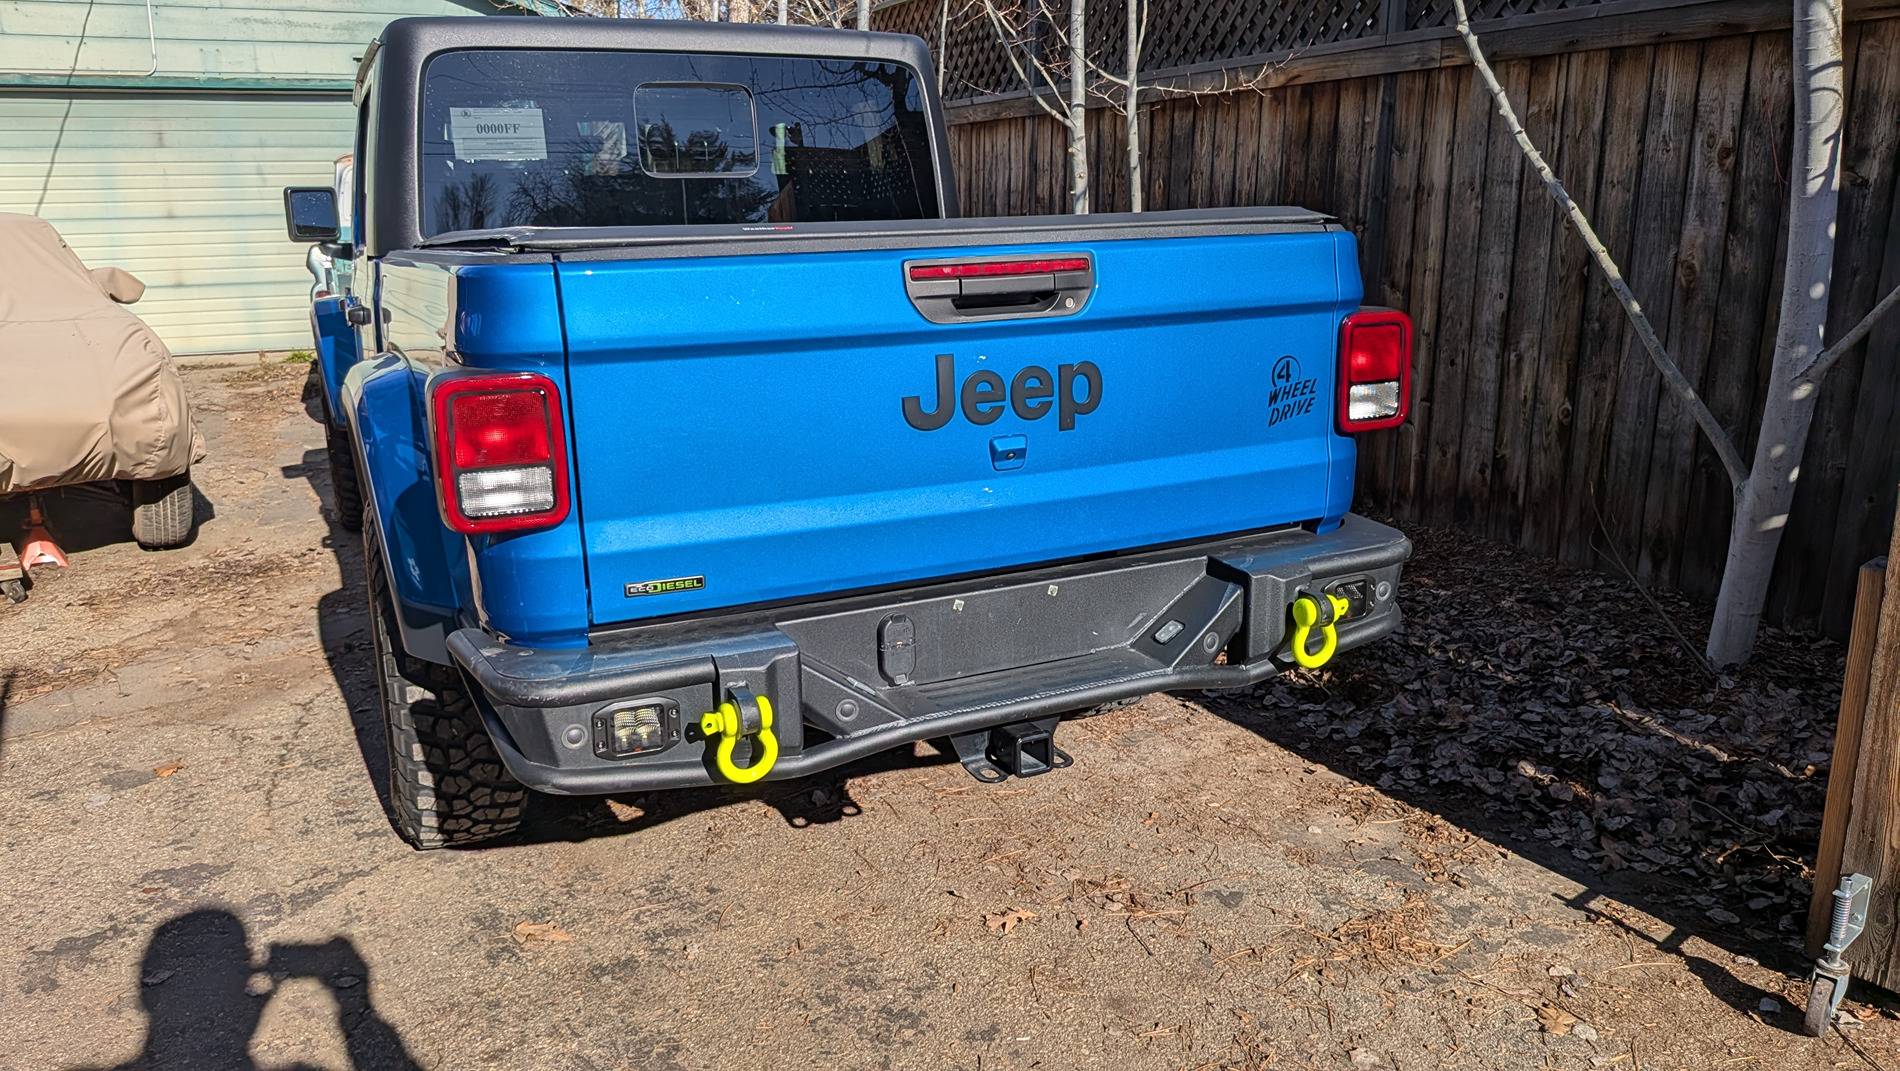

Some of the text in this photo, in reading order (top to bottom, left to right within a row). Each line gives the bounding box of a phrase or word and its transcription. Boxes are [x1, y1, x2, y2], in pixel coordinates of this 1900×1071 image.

[476, 123, 521, 135] 0000FF
[1276, 359, 1292, 384] 4
[901, 353, 1104, 432] Jeep
[1268, 378, 1317, 407] WHEEL
[1268, 397, 1316, 427] DRIVE
